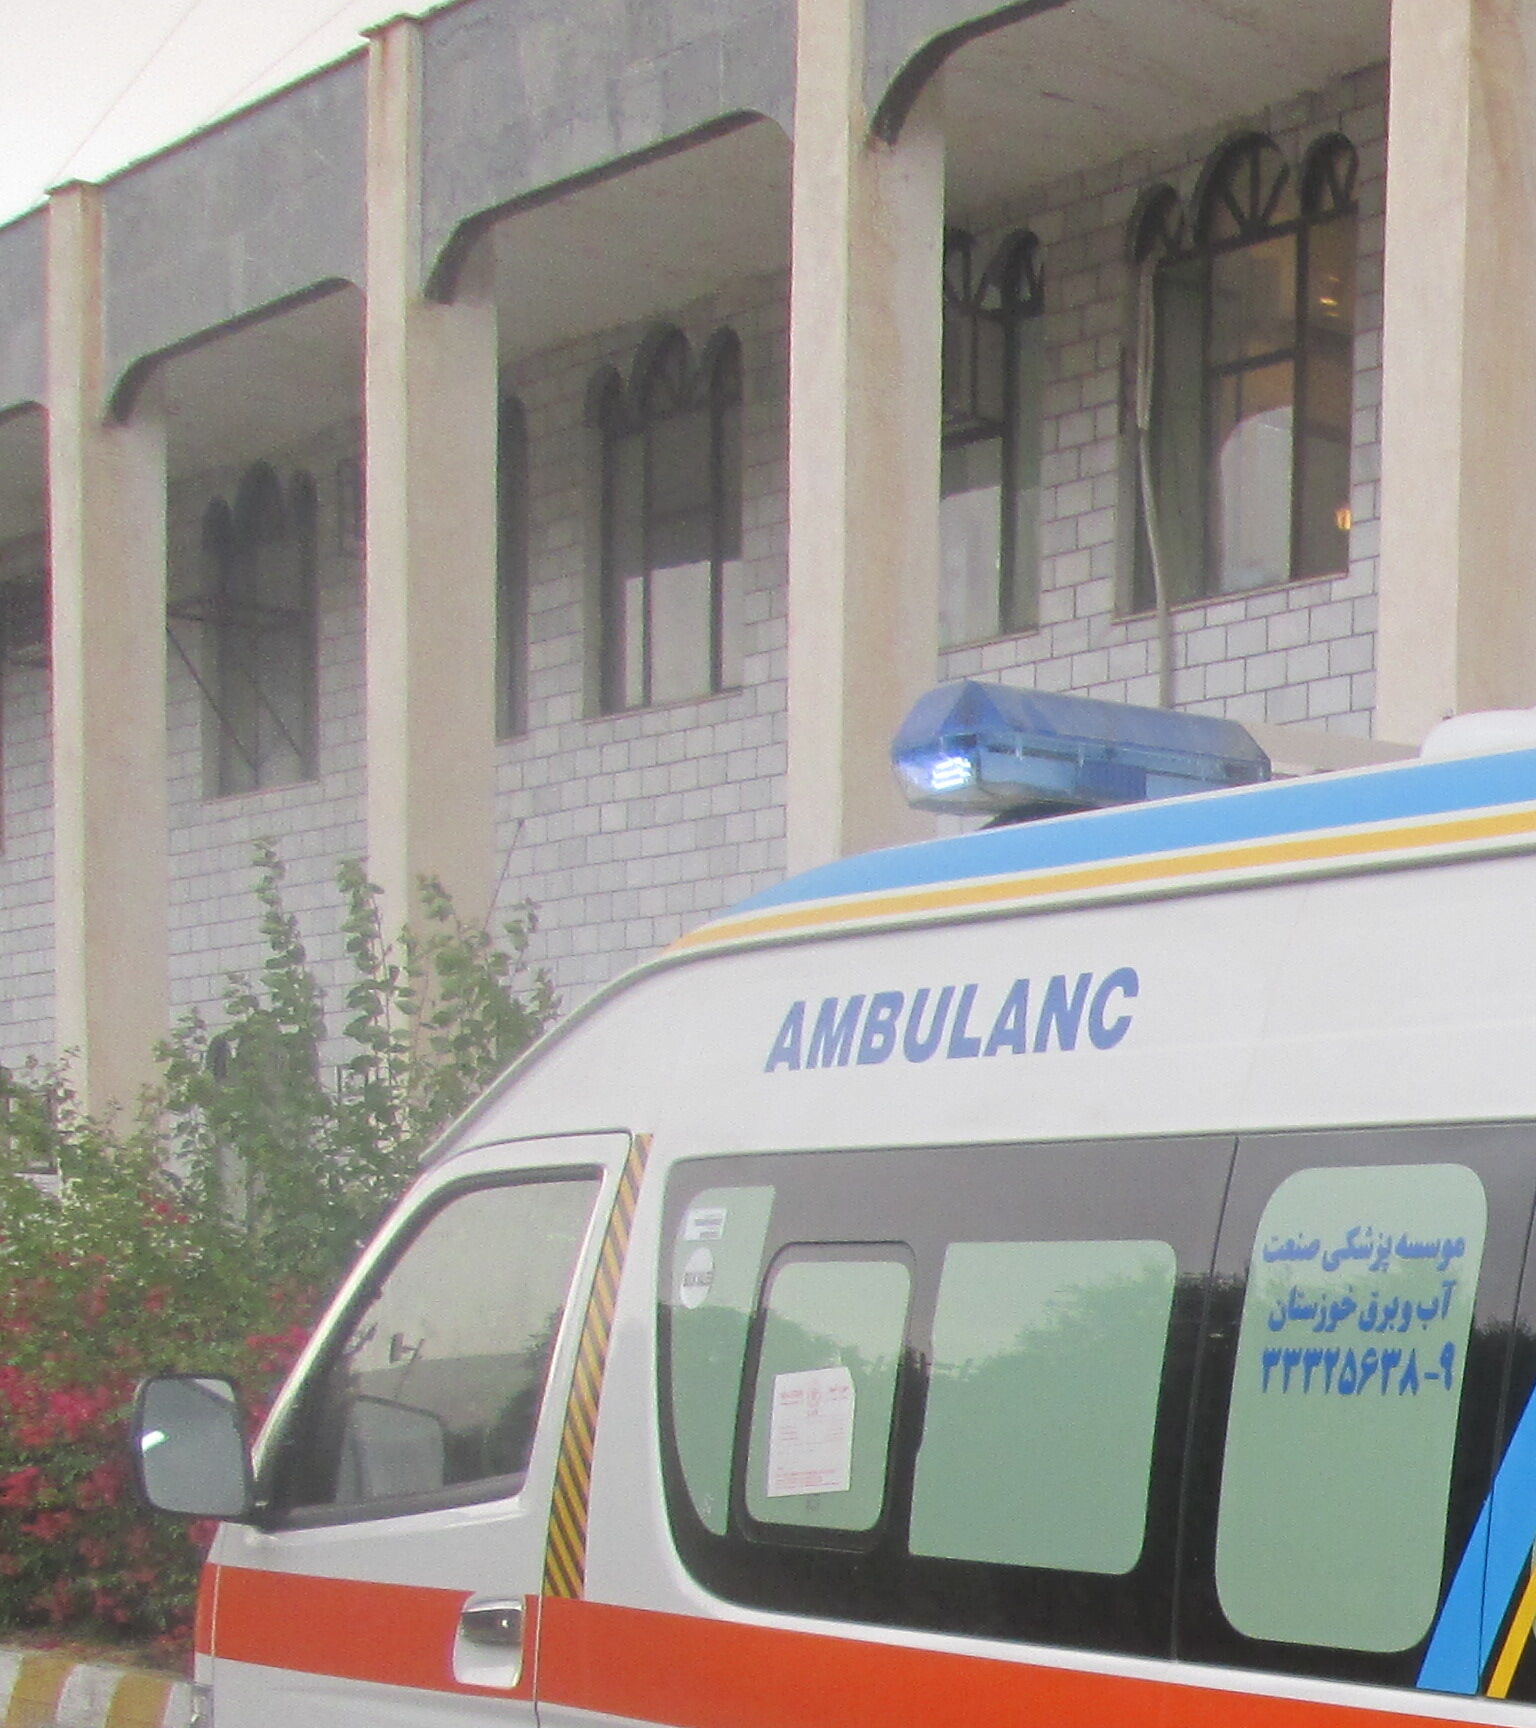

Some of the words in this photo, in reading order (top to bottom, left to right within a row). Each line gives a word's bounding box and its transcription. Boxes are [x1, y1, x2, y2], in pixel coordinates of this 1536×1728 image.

[763, 966, 1140, 1074] AMBULANC
[1263, 1232, 1321, 1263] صنعت
[1322, 1226, 1393, 1272] پزشکی
[1268, 1285, 1358, 1333] خوزستان
[1358, 1291, 1400, 1333] برق
[1416, 1279, 1457, 1330] آب
